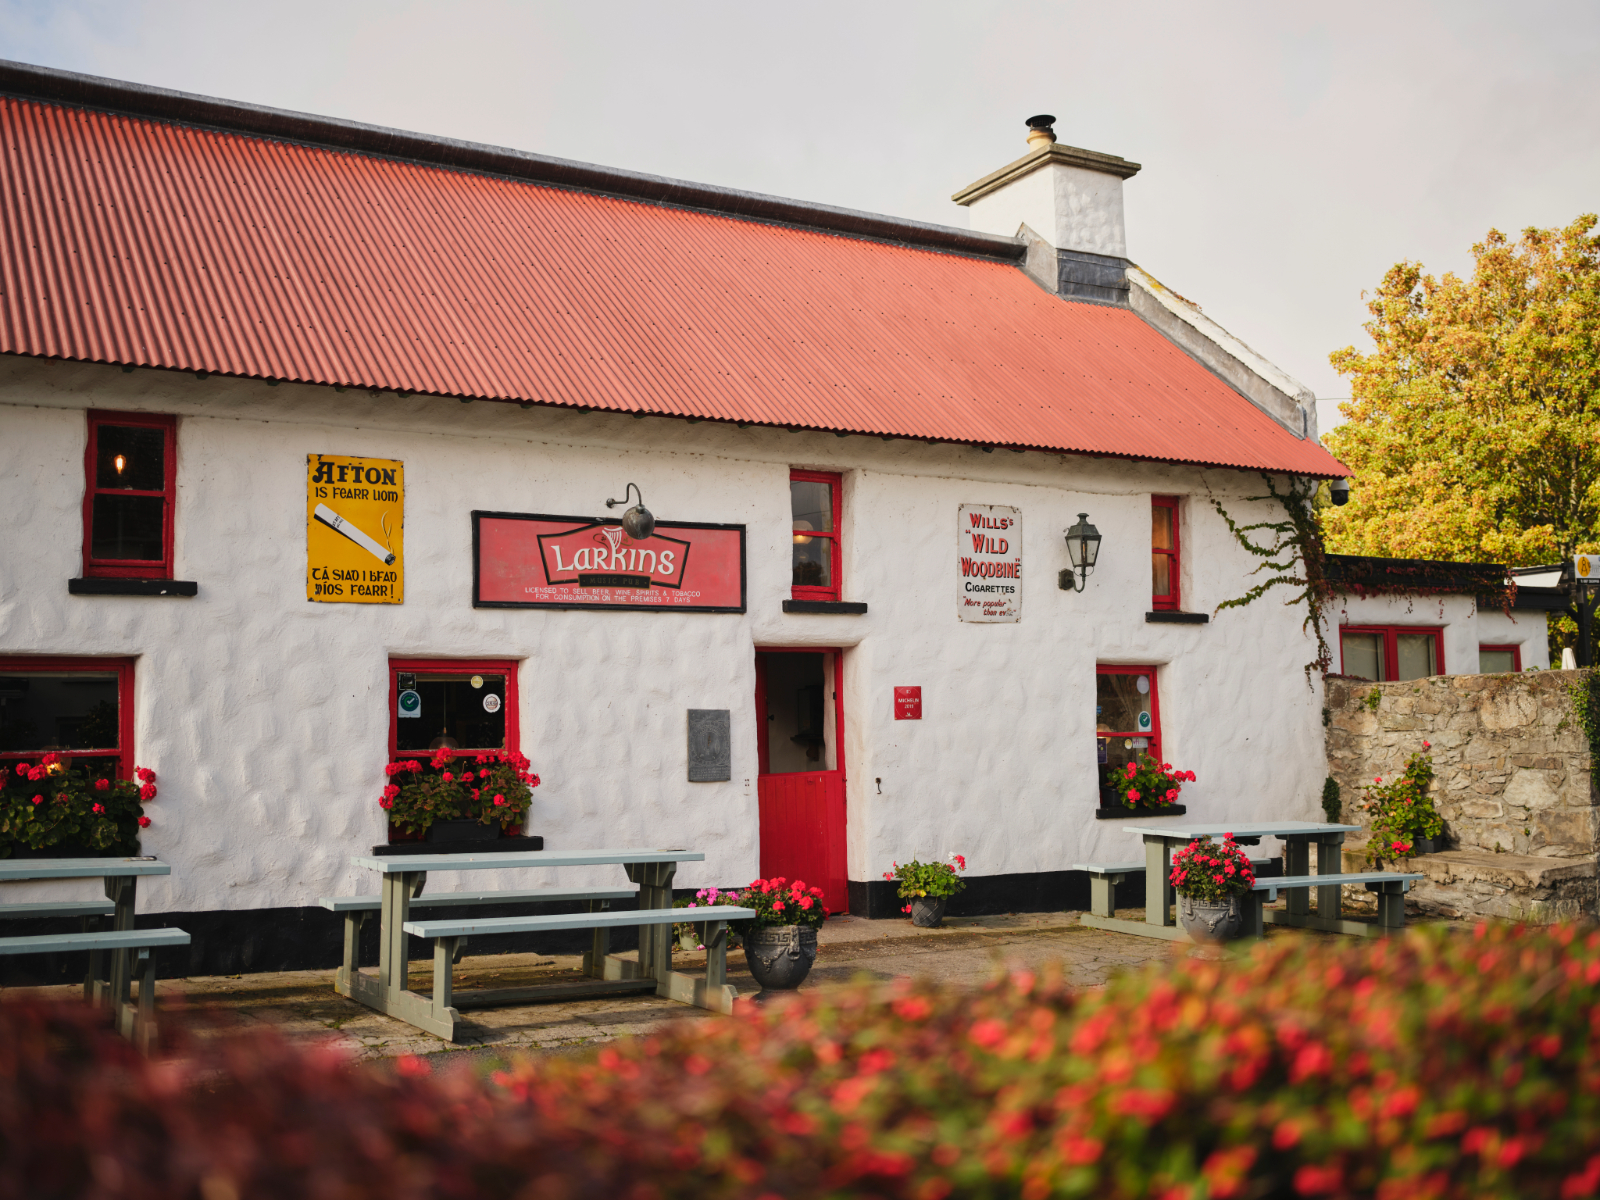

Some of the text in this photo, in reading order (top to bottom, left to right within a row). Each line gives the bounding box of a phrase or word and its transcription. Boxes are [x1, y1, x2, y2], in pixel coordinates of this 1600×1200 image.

[312, 461, 396, 486] AFTON
[315, 486, 328, 498] IS
[960, 556, 1021, 579] WOODBINE"
[671, 590, 701, 598] TOBACCO
[982, 599, 1007, 609] popular
[983, 608, 997, 616] than
